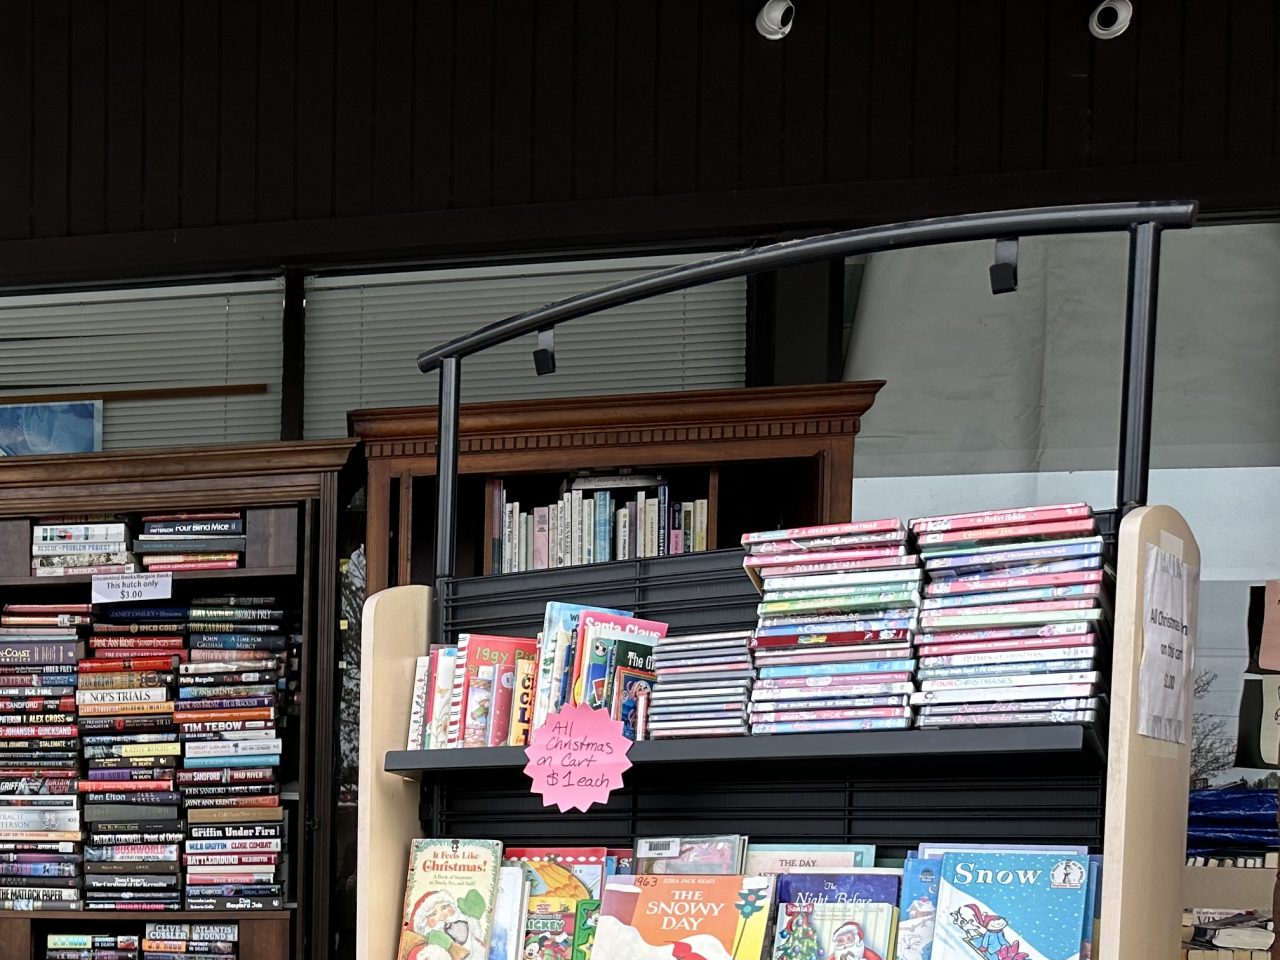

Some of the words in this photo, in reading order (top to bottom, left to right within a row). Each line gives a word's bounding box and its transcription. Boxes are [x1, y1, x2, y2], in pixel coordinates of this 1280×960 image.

[211, 522, 229, 530] Mice
[107, 581, 121, 589] This
[122, 581, 141, 589] hutch
[143, 580, 159, 589] only
[120, 590, 143, 600] $3.00
[585, 617, 622, 633] Santa
[624, 624, 662, 639] Claus
[475, 648, 508, 665] Iggy
[628, 651, 643, 668] The
[91, 692, 114, 702] NOP'S
[116, 691, 151, 700] TRIALS
[6, 701, 38, 709] SANDFORD
[45, 714, 65, 722] CROSS
[5, 727, 35, 735] JOHANSEN
[38, 727, 71, 735] QUICKSAND
[183, 723, 201, 732] TIM
[205, 721, 242, 731] TEBOW
[552, 721, 573, 737] All
[546, 735, 613, 754] Christmas
[537, 756, 552, 766] on
[561, 752, 597, 767] Cart
[193, 772, 220, 781] SANDFORD
[577, 773, 609, 788] each
[1, 782, 23, 790] GRIFFIN
[89, 793, 104, 801] Ben
[105, 793, 126, 801] Elton
[192, 828, 222, 837] Griffin
[225, 827, 253, 836] Under
[255, 827, 275, 835] Fire
[116, 835, 141, 843] CORNWELL
[114, 845, 165, 854] BUSHWORLD
[187, 856, 238, 864] BATTLEGROUND
[462, 851, 479, 859] Like
[422, 860, 487, 873] Christmas!
[779, 859, 796, 867] THE
[798, 859, 818, 867] DAY
[954, 862, 1042, 885] Snow
[634, 877, 658, 887] 1963
[824, 881, 837, 890] The
[11, 889, 40, 899] MATLOCK
[42, 889, 62, 899] PAPER
[671, 891, 703, 900] THE
[795, 892, 828, 903] Night
[835, 892, 873, 903] Before
[646, 901, 725, 916] SNOWY
[661, 917, 704, 931] DAY
